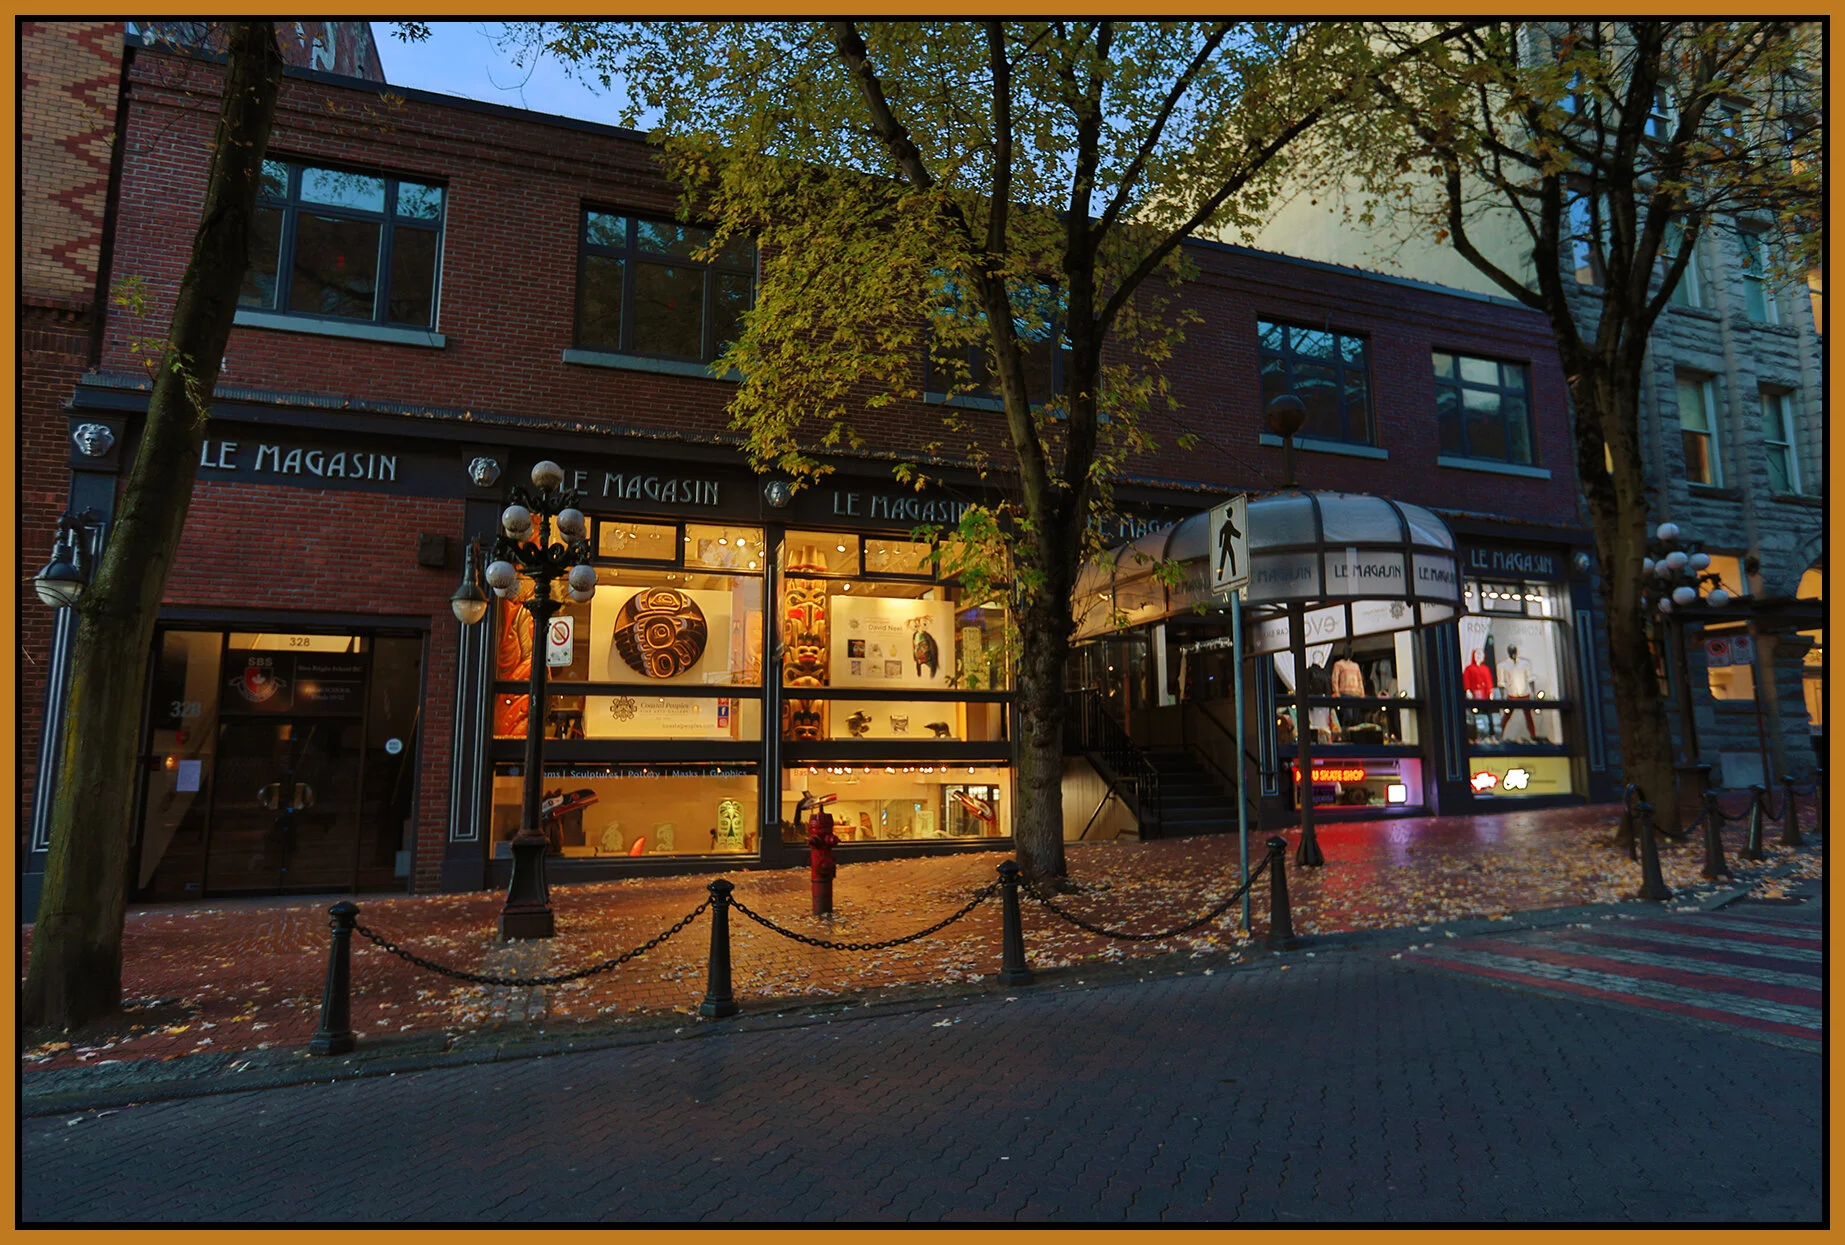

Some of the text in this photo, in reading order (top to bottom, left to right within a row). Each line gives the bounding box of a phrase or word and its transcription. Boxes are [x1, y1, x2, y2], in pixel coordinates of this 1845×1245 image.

[200, 440, 397, 481] LE MAGASIN
[602, 472, 719, 505] MAGASIN
[833, 491, 861, 516] LE
[1471, 548, 1553, 575] LE MAGASIN
[1334, 563, 1402, 578] LE MAGASIN
[289, 637, 311, 647] 328
[248, 657, 273, 667] SBS
[169, 701, 201, 718] 328
[570, 769, 618, 779] Sculptures
[709, 769, 747, 779] Graphics
[1320, 769, 1342, 781] SKATE
[1343, 769, 1365, 781] SHOP
